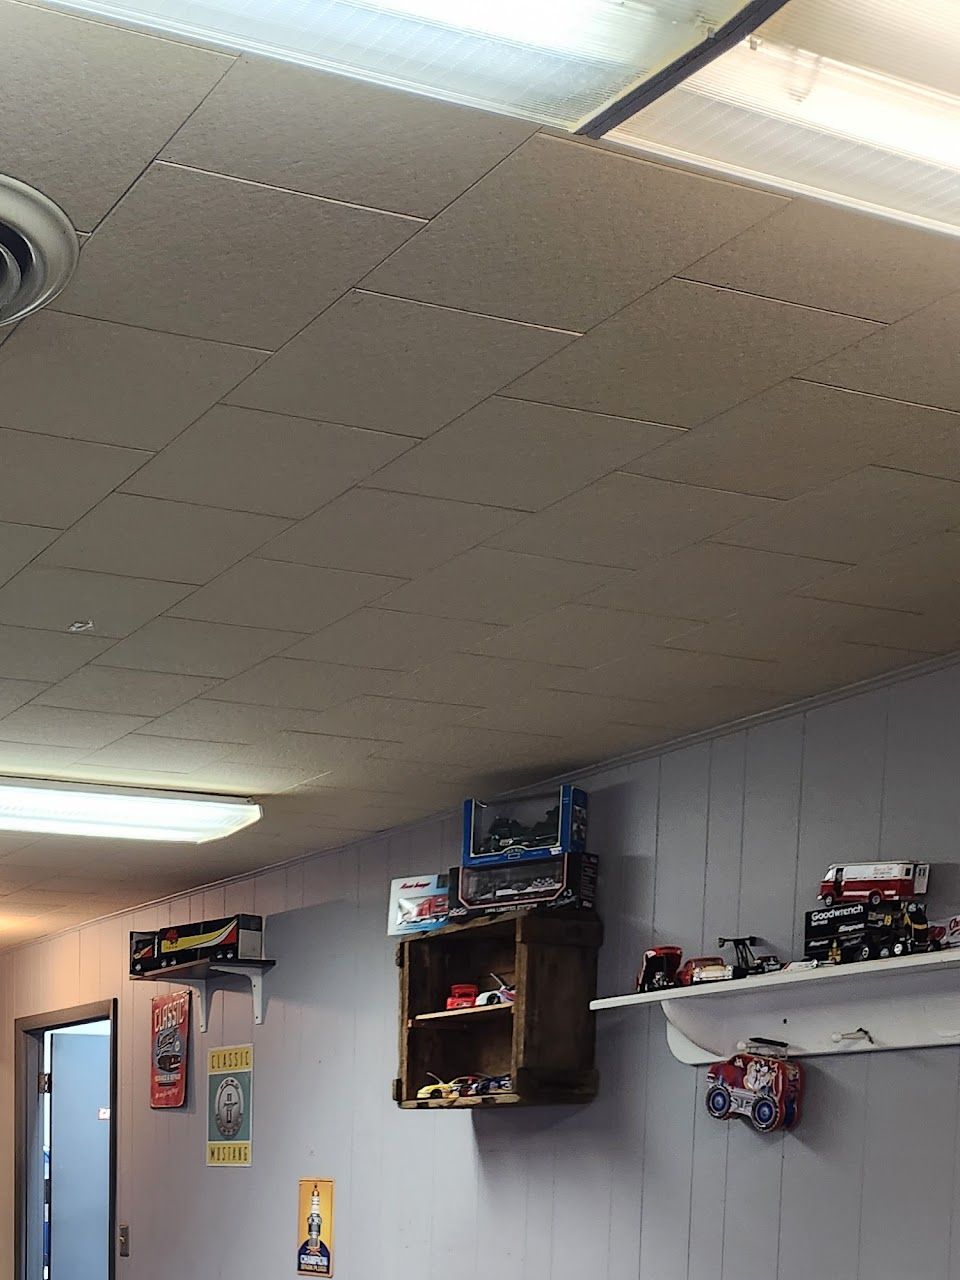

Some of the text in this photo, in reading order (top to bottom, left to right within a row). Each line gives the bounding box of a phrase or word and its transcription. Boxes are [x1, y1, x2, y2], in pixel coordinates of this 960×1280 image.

[811, 904, 864, 921] Goodwrench
[155, 999, 185, 1032] CLASSIC
[211, 1051, 249, 1069] CLASSIC
[210, 1146, 248, 1161] MUSTANG
